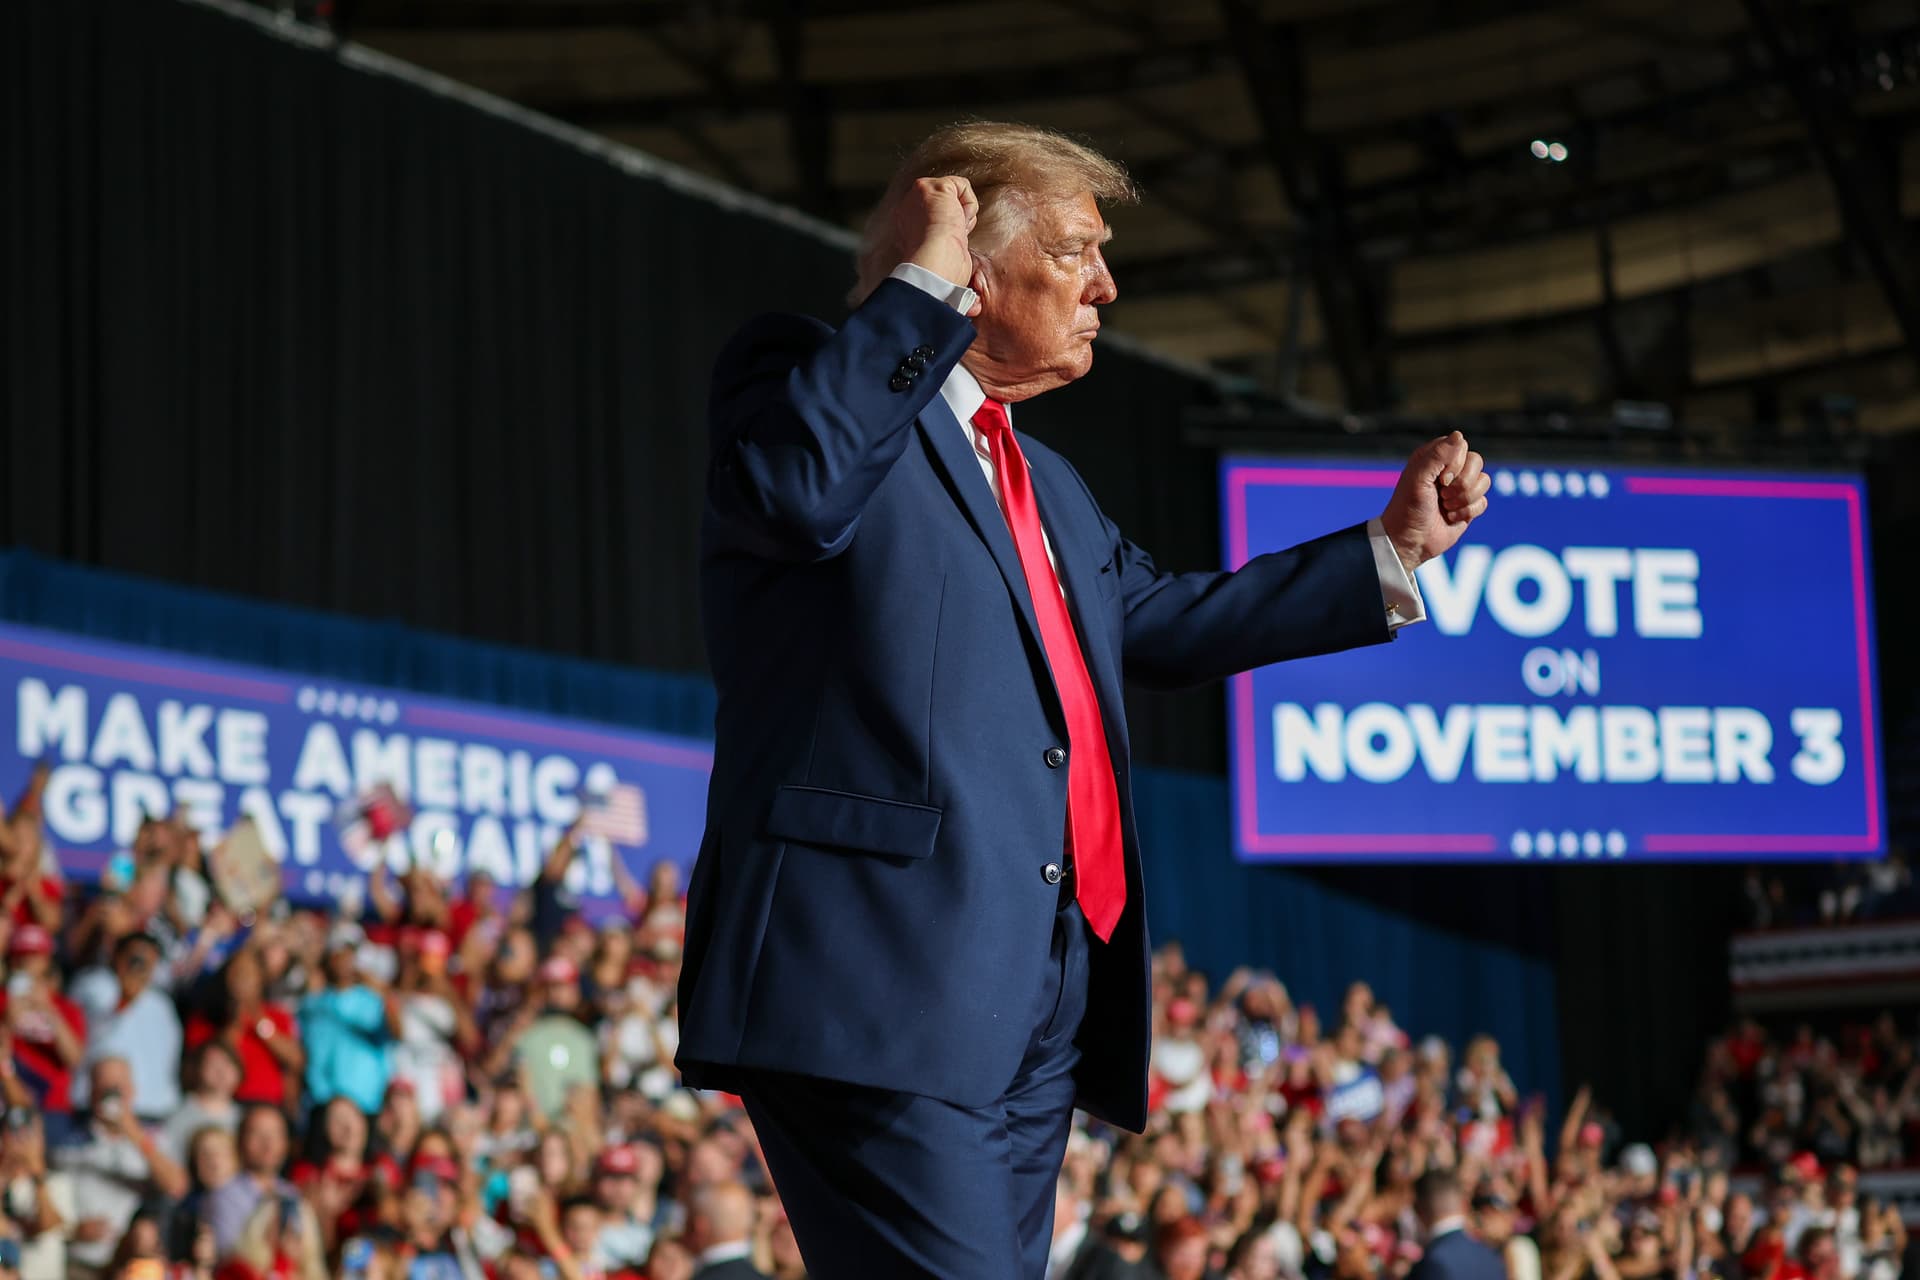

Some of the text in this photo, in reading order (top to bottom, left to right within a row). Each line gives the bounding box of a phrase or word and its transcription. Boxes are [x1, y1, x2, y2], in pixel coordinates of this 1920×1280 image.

[1416, 543, 1702, 639] VOTE
[1521, 646, 1600, 697] ON
[17, 677, 270, 785] MAKE
[1273, 702, 1845, 786] NOVEMBER 3
